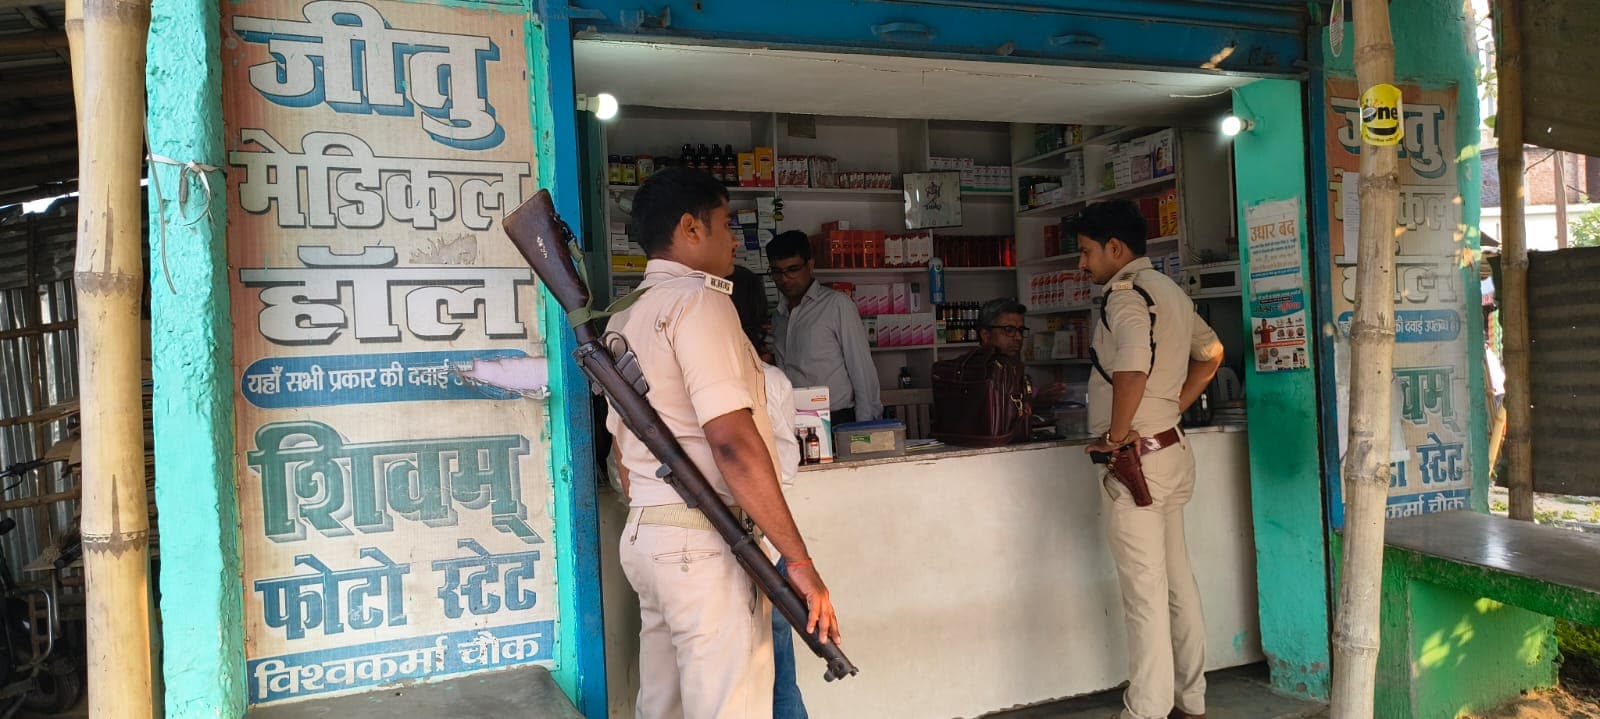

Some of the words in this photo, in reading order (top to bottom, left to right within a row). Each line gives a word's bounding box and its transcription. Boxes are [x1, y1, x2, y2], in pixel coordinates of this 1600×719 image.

[233, 0, 504, 149] जीतु
[229, 128, 530, 230] मेडिकल
[1249, 223, 1275, 241] उधार
[240, 245, 533, 345] हॉल
[1405, 315, 1423, 334] दवाई
[247, 366, 281, 394] यहाँ
[286, 365, 324, 392] सभी
[328, 368, 376, 393] प्रकार
[379, 361, 404, 387] की
[407, 359, 449, 389] दवाई
[247, 420, 544, 543] शिवम्
[1416, 432, 1464, 485] स्टेट
[254, 546, 410, 641] फोटो
[432, 538, 541, 619] स्टेट
[254, 636, 449, 699] विश्वकर्मा
[459, 631, 543, 666] चौक
